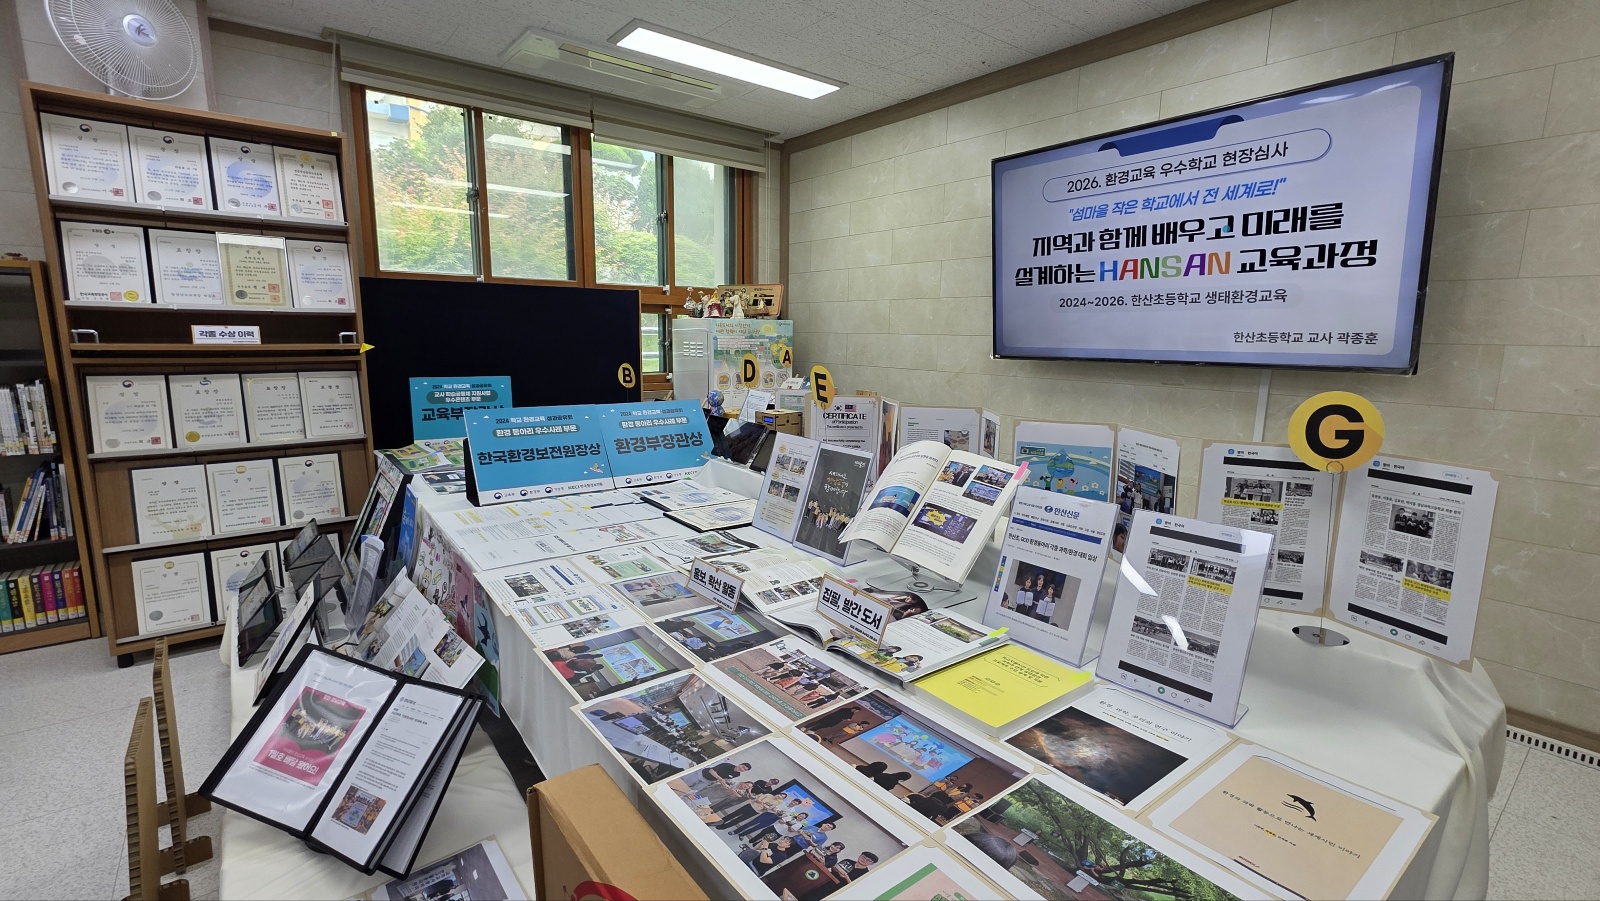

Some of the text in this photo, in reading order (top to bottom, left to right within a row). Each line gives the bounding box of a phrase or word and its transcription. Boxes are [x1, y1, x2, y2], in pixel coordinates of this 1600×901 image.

[1067, 141, 1289, 193] 2026. 환경교육 우수학교 현장심사
[1111, 199, 1138, 215] 작은
[1141, 190, 1200, 212] 학교에서
[1202, 187, 1219, 204] 전
[1032, 202, 1344, 257] 지역과 함께 배우고 미래를
[1015, 239, 1378, 287] 설계하는 HANSAN 교육과정
[1059, 288, 1287, 308] 2024~2026. 한산초등학교 생태환경교육
[1233, 331, 1379, 345] 한산초등학교 교사 곽종훈
[782, 349, 791, 364] A
[621, 367, 633, 383] B
[743, 359, 756, 382] D
[813, 371, 829, 403] E
[621, 421, 634, 429] 환경
[653, 418, 676, 426] 우수사례
[823, 412, 867, 420] CERTIFICATE
[495, 429, 511, 437] 환경
[512, 427, 534, 436] 동아리
[534, 426, 562, 435] 우수사례
[614, 431, 704, 454] 환경부장관상
[1305, 404, 1365, 459] G
[477, 443, 601, 465] 한국환경보전원장상
[1054, 507, 1080, 520] 한산신문
[693, 567, 736, 599] 홍보, 확산 활동
[823, 587, 883, 631] 집필, 발간 도서
[1284, 820, 1305, 832] 만나는
[1307, 831, 1336, 848] 세계시민
[1338, 845, 1361, 859] 이야기
